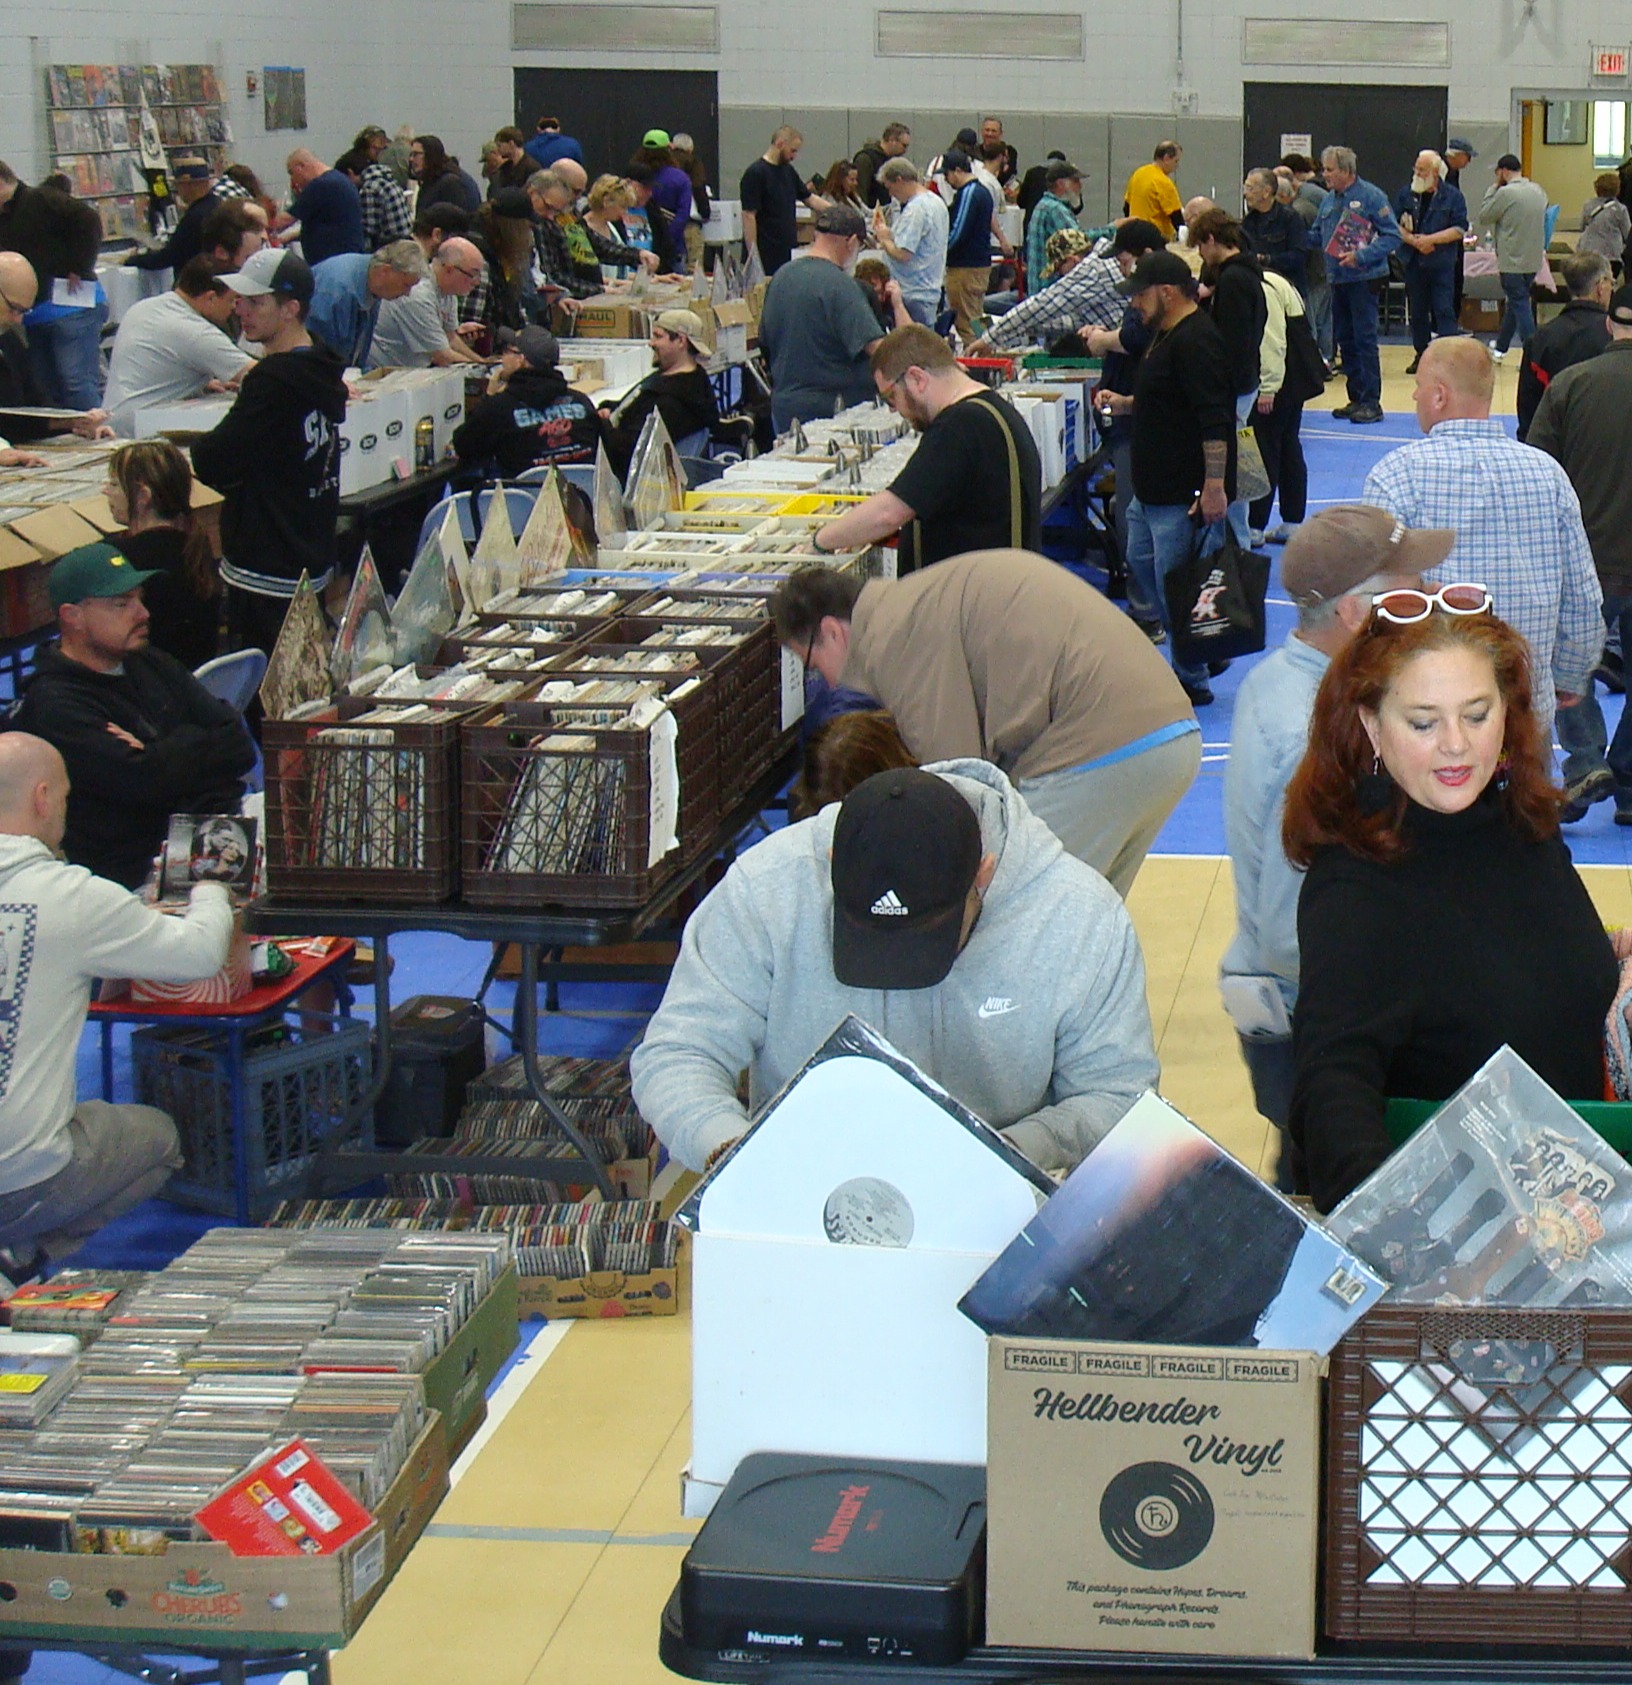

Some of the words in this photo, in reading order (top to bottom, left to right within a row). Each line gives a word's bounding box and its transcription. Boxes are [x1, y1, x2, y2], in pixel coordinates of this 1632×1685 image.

[1600, 54, 1622, 71] EXIT
[871, 905, 909, 916] adidas
[984, 996, 1012, 1010] NIKE
[1012, 1354, 1068, 1367] FRAGILE
[1086, 1358, 1142, 1371] FRAGILE
[1160, 1362, 1216, 1374] FRAGILE
[1233, 1364, 1290, 1377] FRAGILE
[1033, 1387, 1222, 1426] Hellbender
[1183, 1433, 1285, 1477] Vinyl
[809, 1485, 871, 1553] Numark
[747, 1631, 804, 1647] Numark
